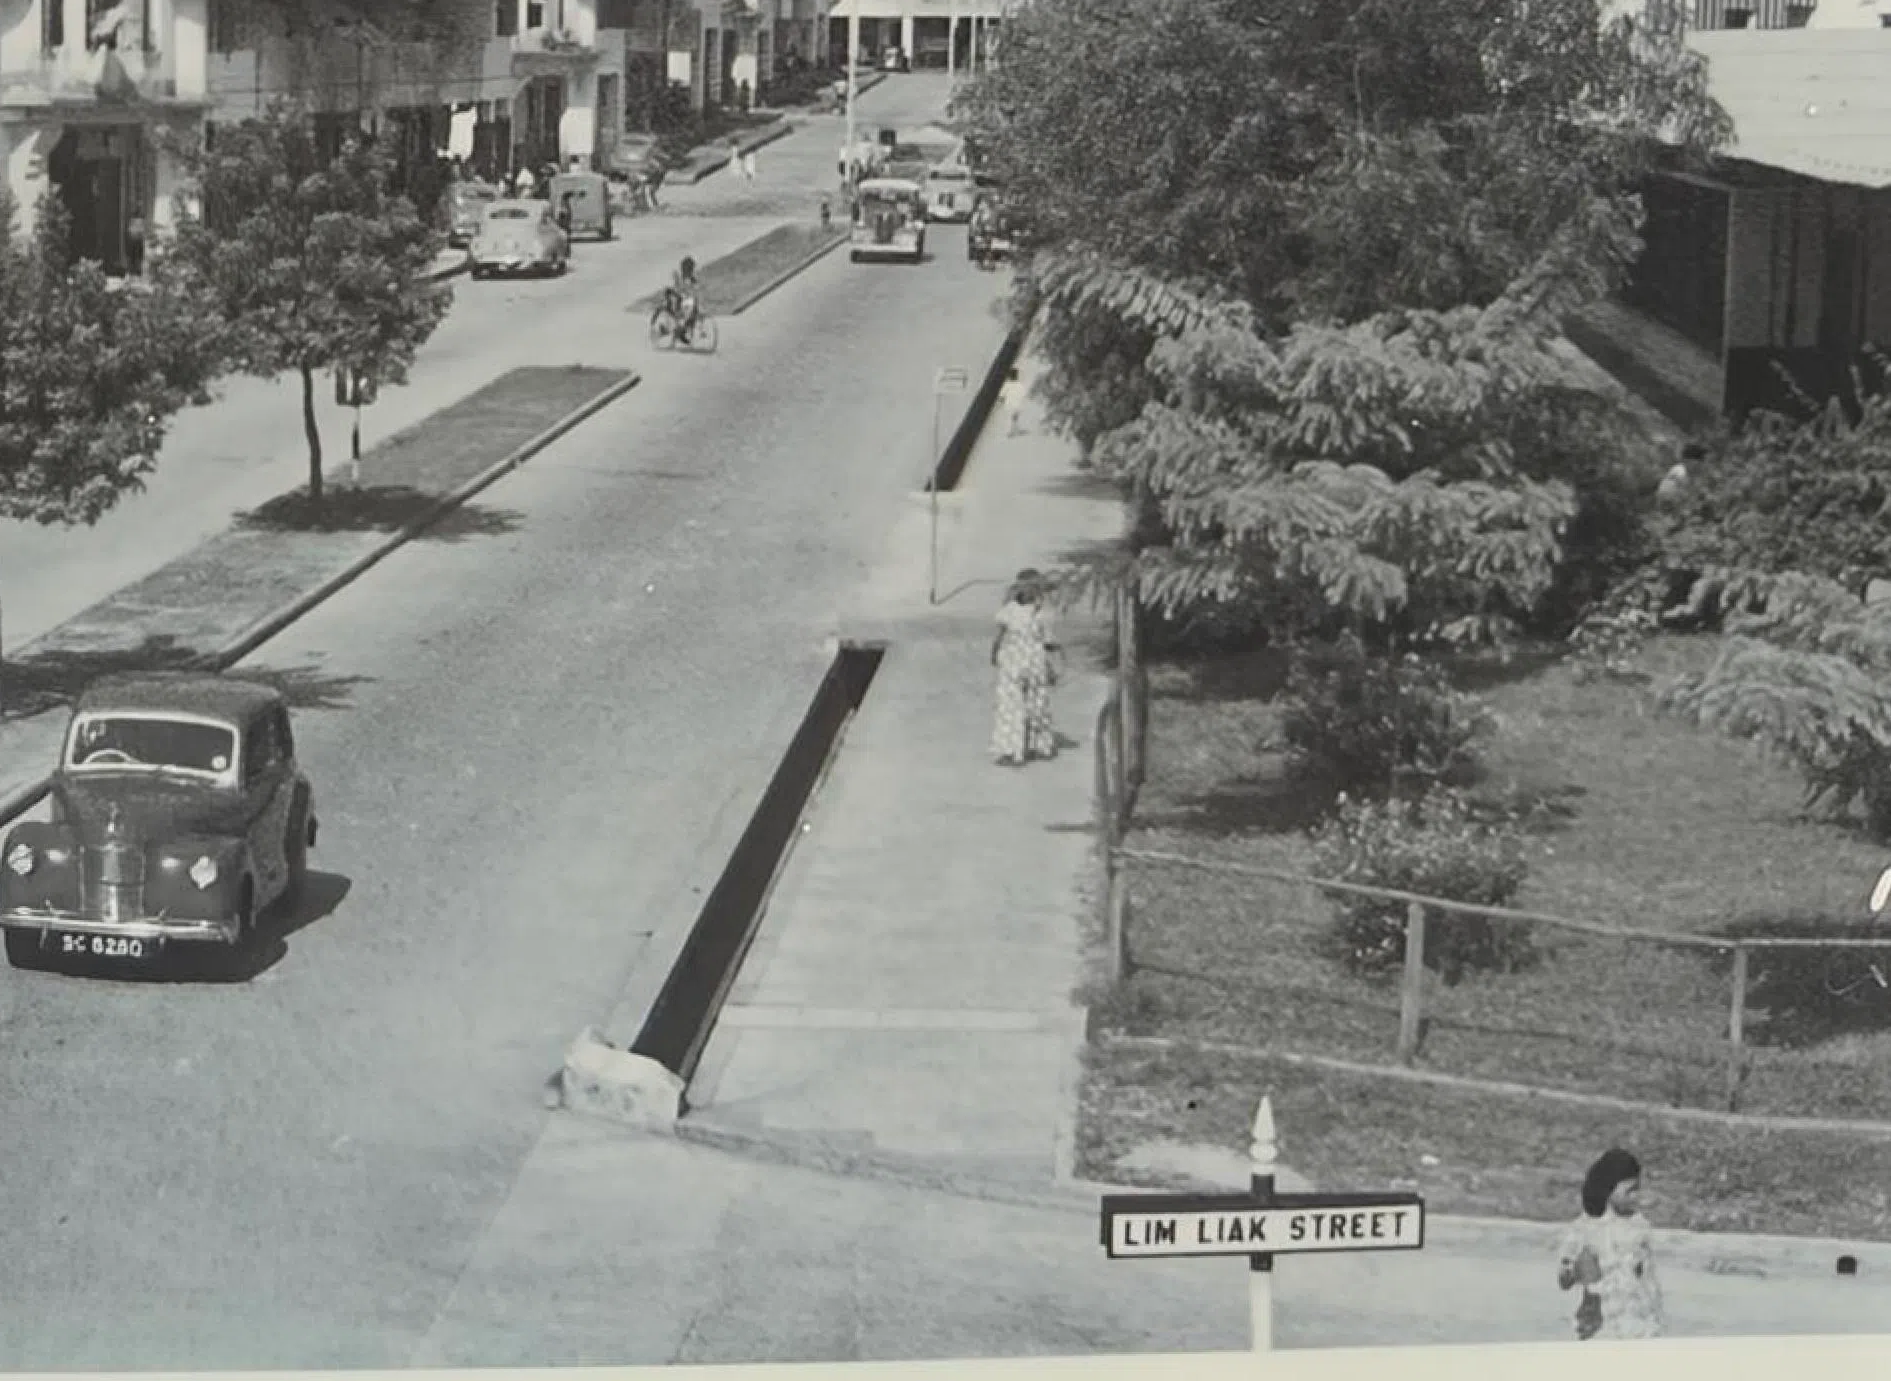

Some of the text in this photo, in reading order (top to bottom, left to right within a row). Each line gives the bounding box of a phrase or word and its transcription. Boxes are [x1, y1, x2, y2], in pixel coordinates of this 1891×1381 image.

[1123, 1211, 1408, 1246] LIM LIAK STREET
